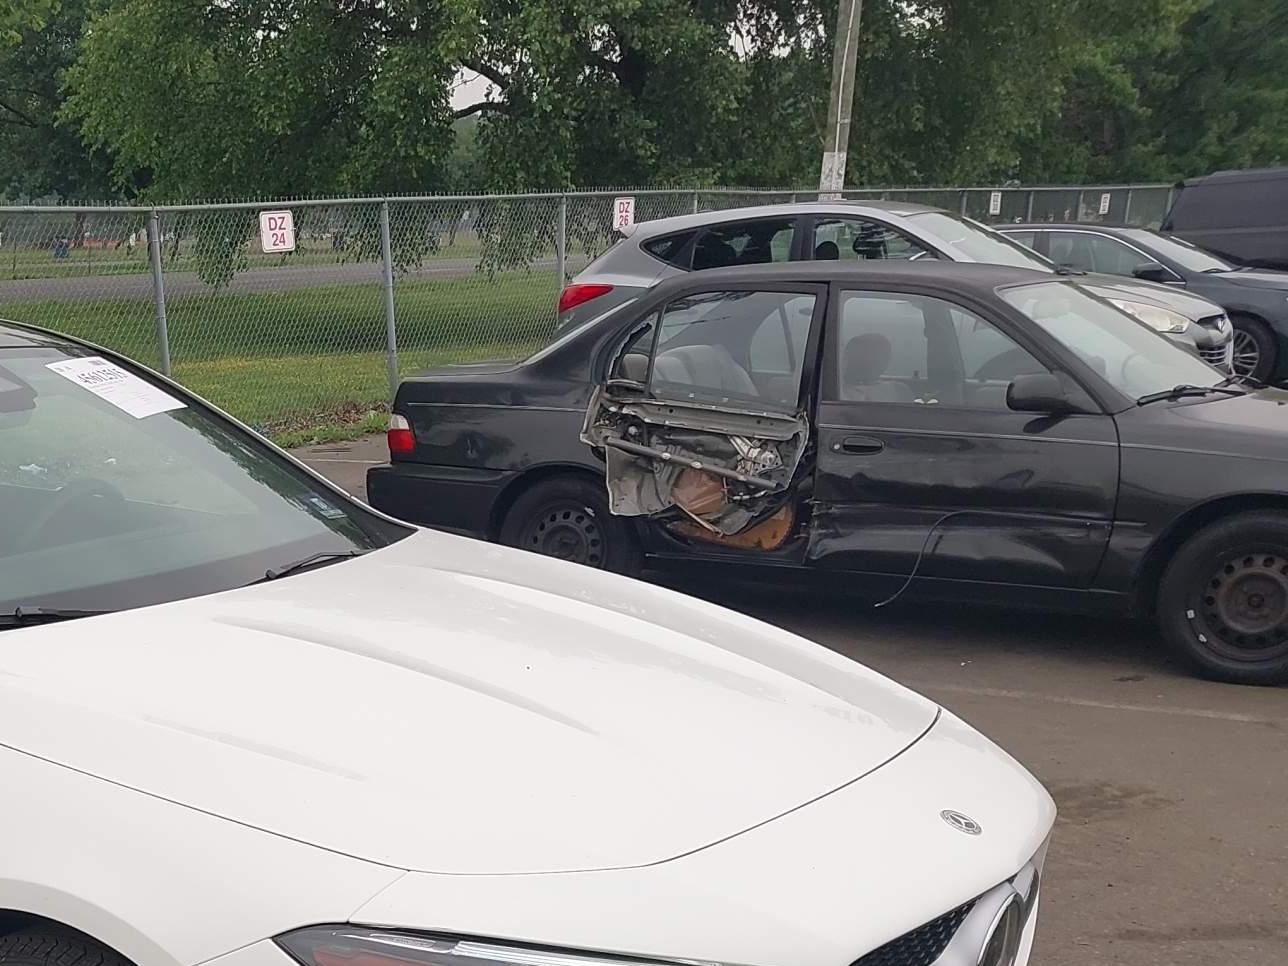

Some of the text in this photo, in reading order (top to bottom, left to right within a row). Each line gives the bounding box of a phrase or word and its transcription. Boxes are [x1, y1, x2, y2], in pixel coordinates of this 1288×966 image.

[619, 202, 630, 213] DZ
[268, 216, 286, 231] DZ
[619, 215, 629, 226] 26
[272, 232, 286, 246] 24
